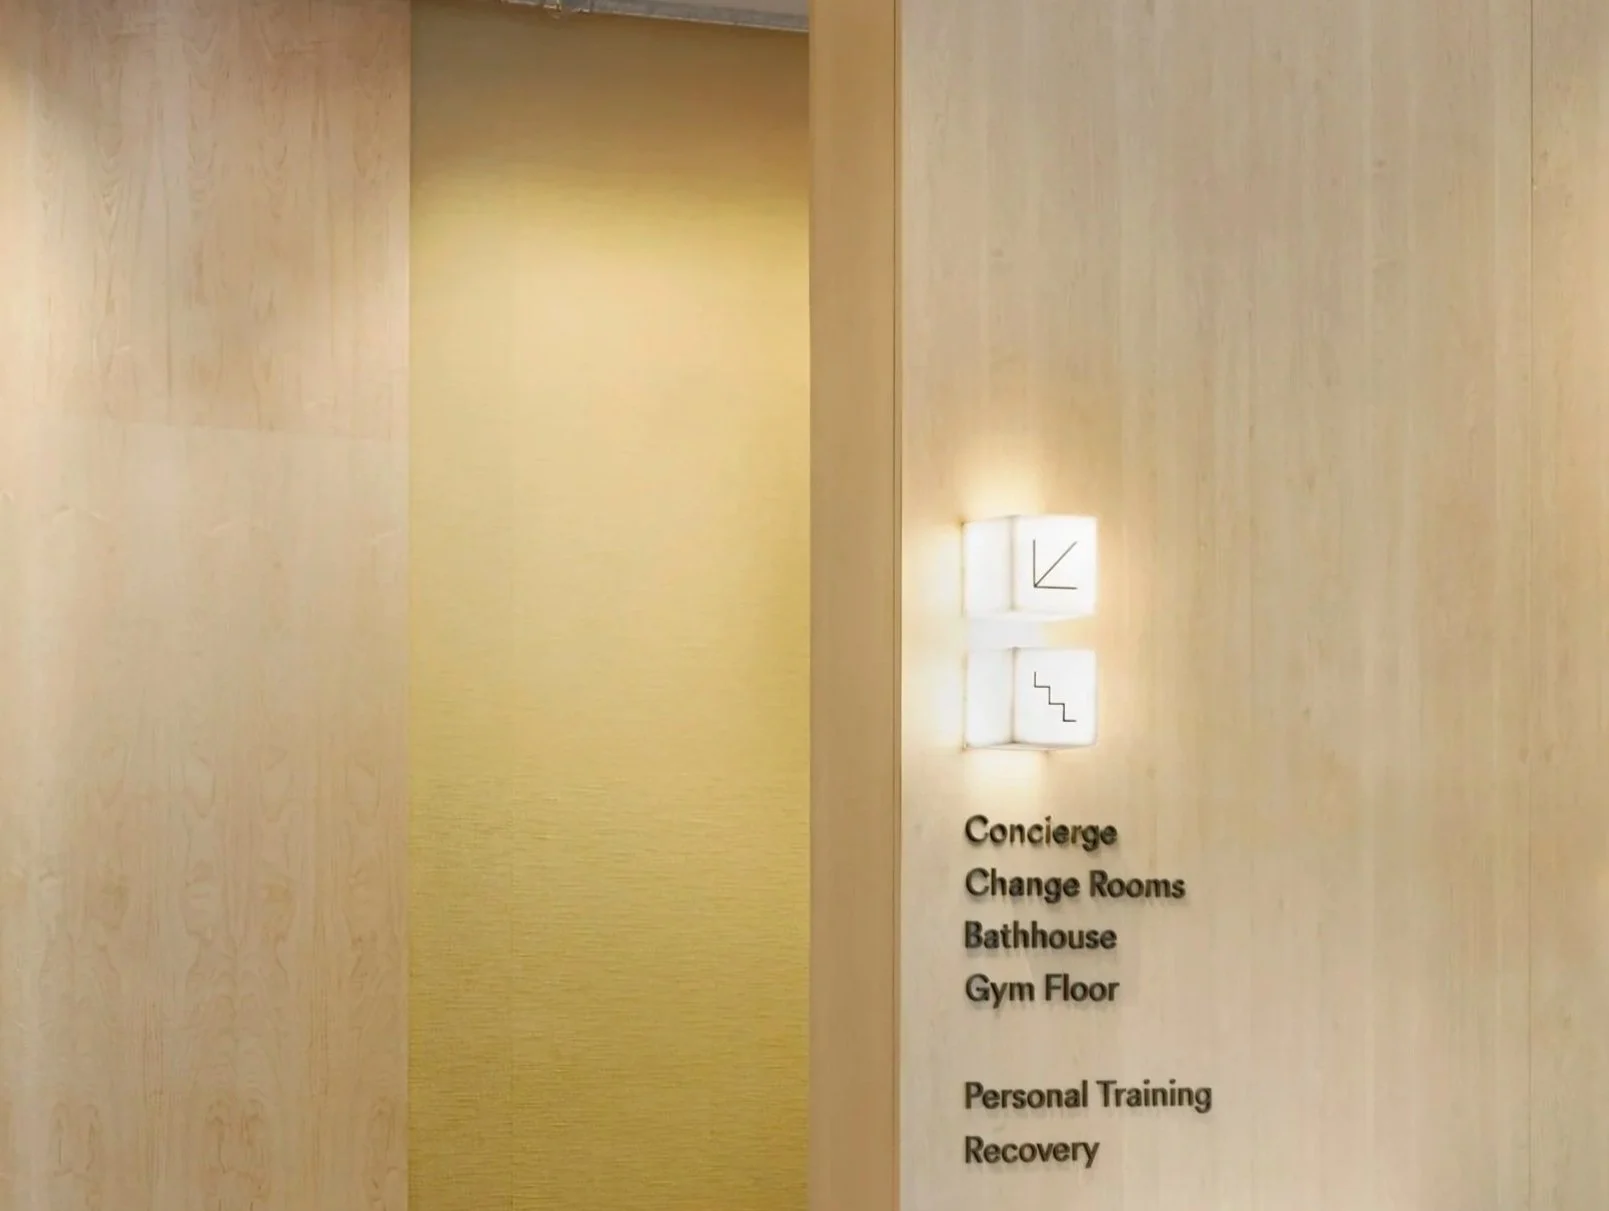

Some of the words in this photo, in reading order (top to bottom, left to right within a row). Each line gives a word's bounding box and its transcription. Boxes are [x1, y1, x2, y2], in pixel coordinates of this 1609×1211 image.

[965, 814, 1118, 851] Concierge
[965, 868, 1080, 903] Change
[1089, 870, 1186, 899] Rooms
[964, 920, 1117, 950] Bathhouse
[965, 974, 1034, 1008] Gym
[1044, 974, 1120, 1002] Floor
[965, 1080, 1088, 1109] Personal
[1097, 1079, 1212, 1113] Training
[965, 1136, 1100, 1168] Recovery
